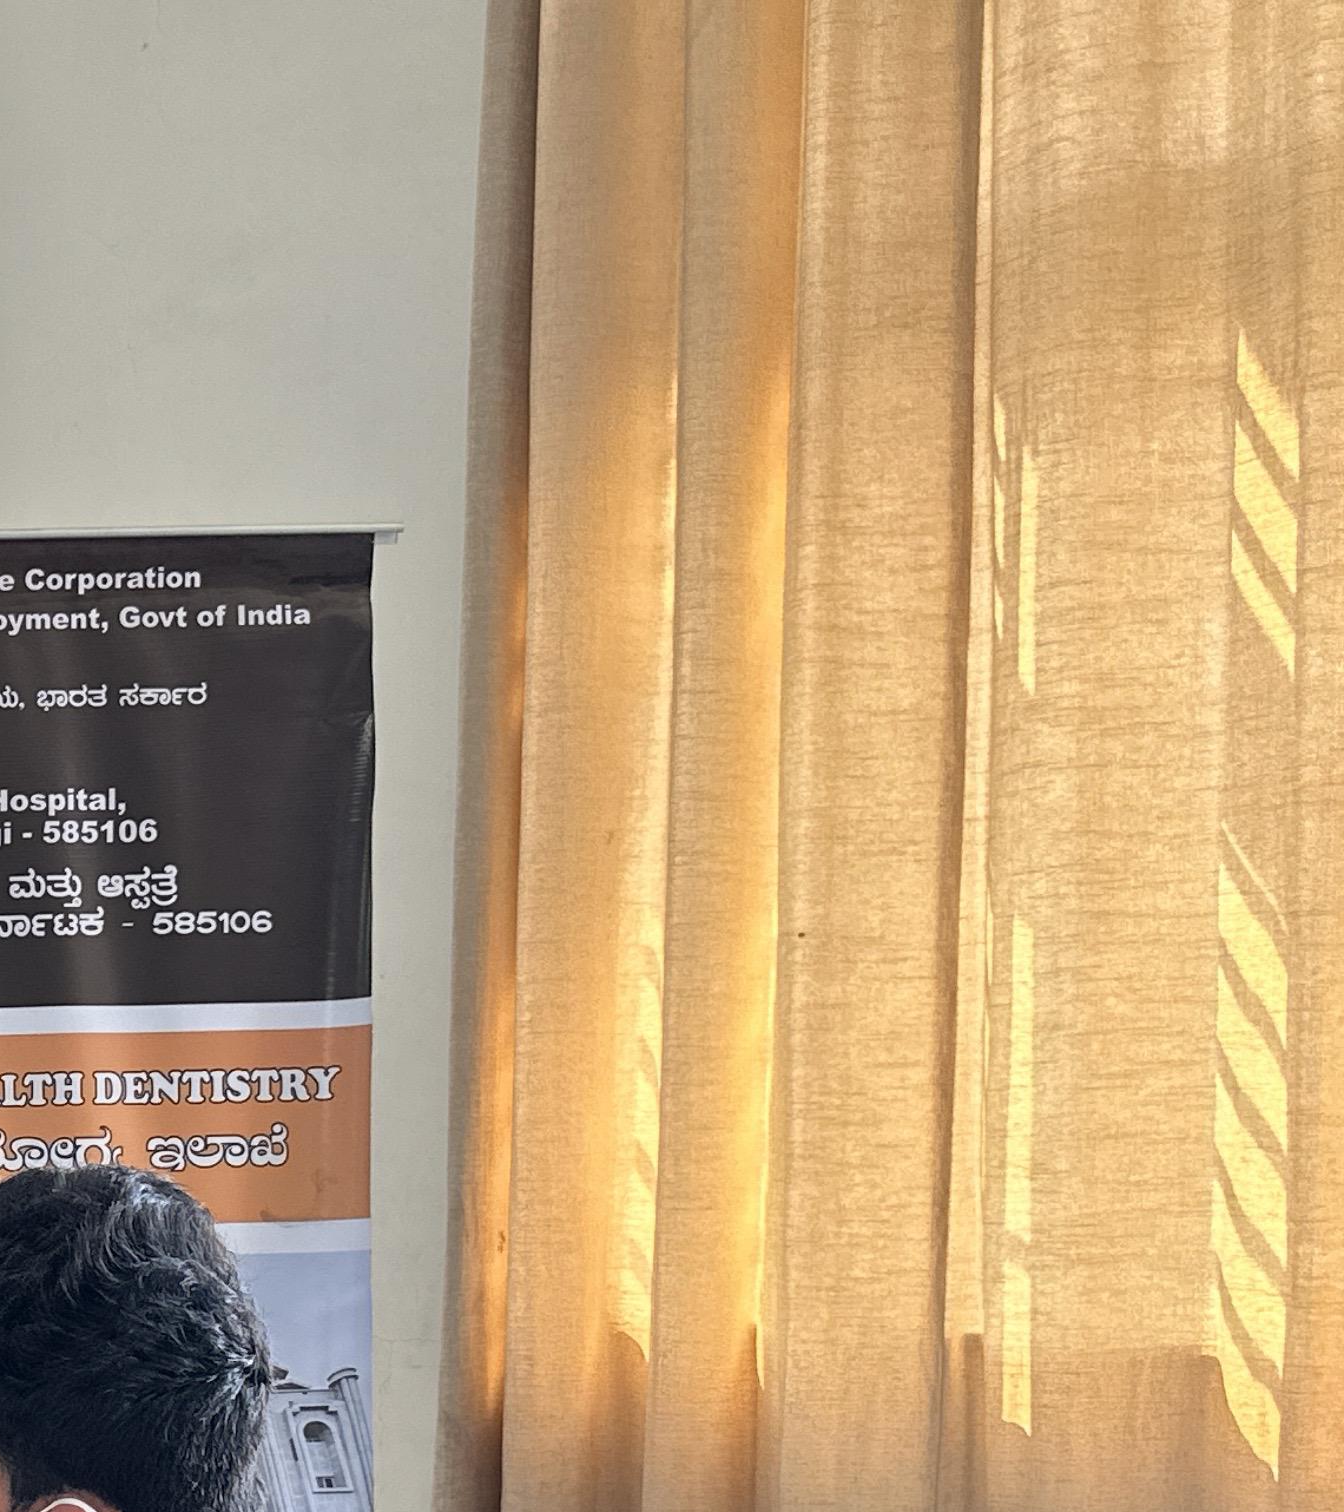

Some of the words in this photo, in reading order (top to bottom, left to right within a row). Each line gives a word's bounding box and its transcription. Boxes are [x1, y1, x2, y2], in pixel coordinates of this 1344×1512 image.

[24, 566, 202, 596] Corporation
[119, 605, 188, 629] Govt
[196, 604, 227, 628] of
[237, 603, 311, 626] India
[42, 818, 158, 845] 585106
[152, 909, 273, 936] 585106
[90, 1065, 340, 1119] DENTISTRY
